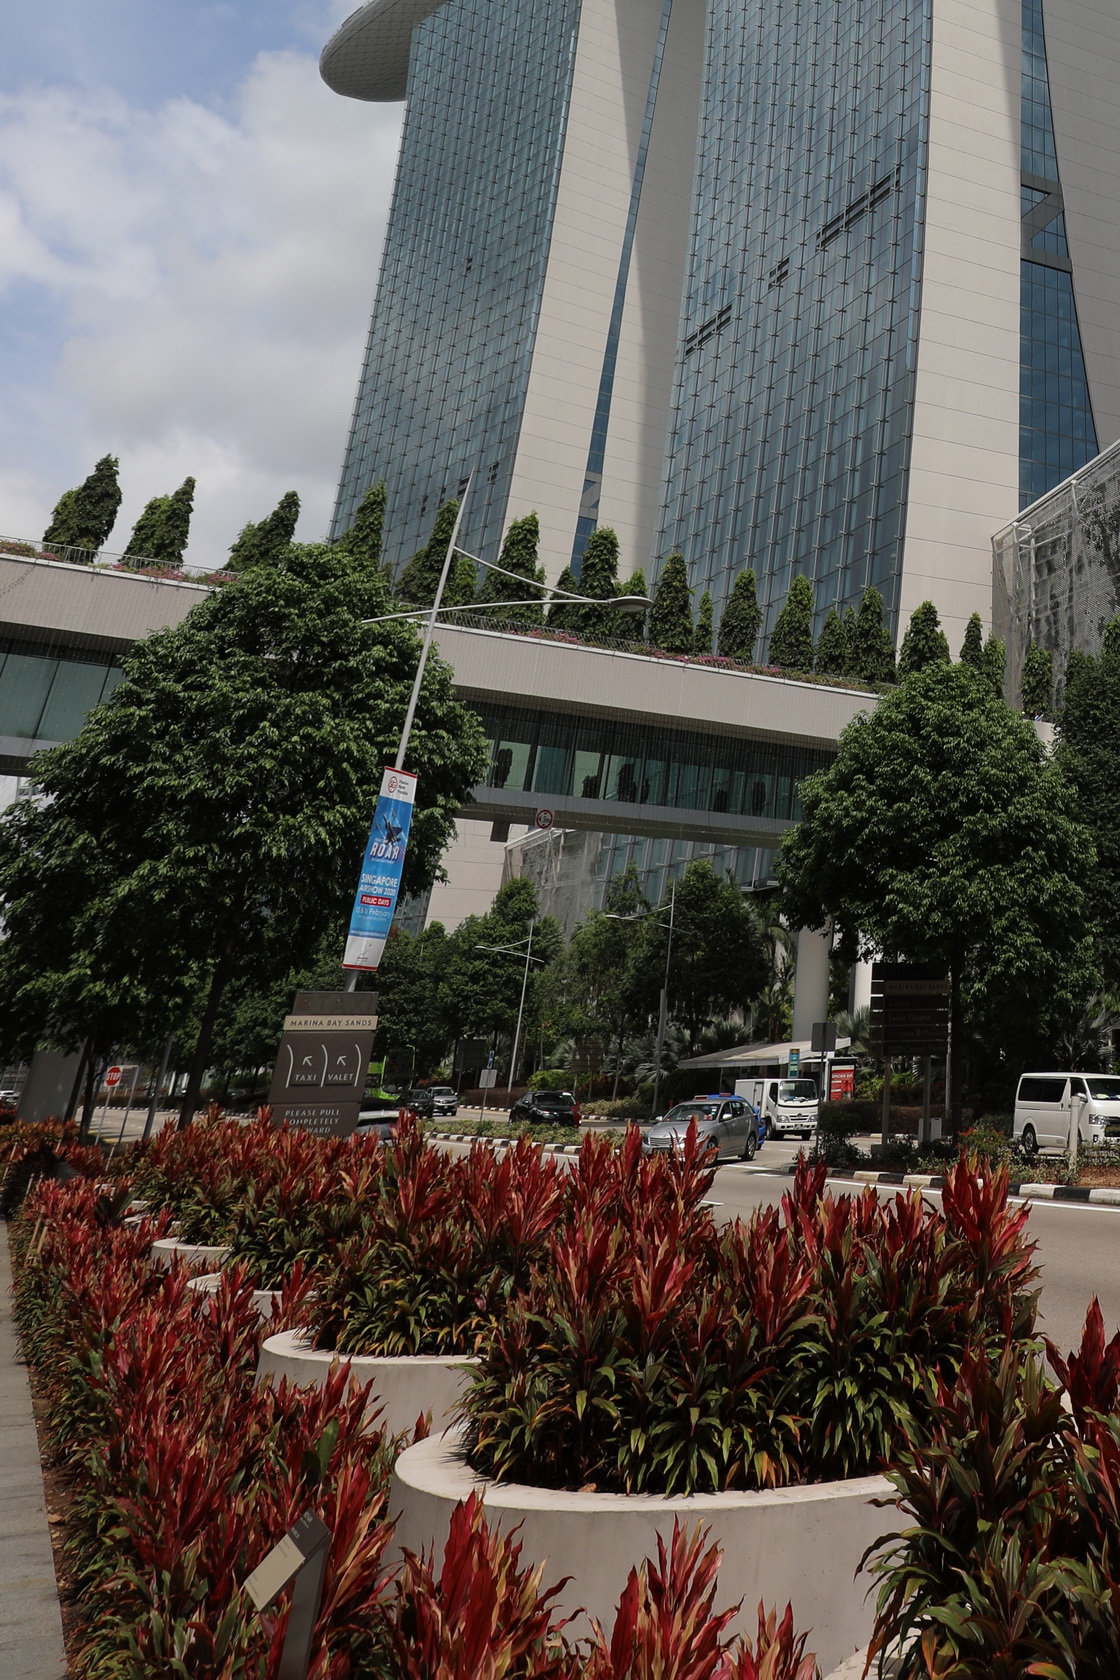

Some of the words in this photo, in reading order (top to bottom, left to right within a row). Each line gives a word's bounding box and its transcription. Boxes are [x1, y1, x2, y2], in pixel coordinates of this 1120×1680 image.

[370, 842, 400, 860] ROAR
[361, 873, 398, 888] SINGAPORE
[360, 884, 384, 894] AIRSHOW
[383, 887, 396, 896] 2020
[362, 896, 377, 905] PUBLIC
[377, 898, 390, 906] DAYS
[369, 907, 392, 919] February
[290, 1019, 324, 1027] MARINA
[106, 1072, 121, 1081] STOP
[327, 1073, 354, 1081] VALET
[285, 1109, 317, 1117] PLEASE
[319, 1108, 340, 1116] PULL
[288, 1118, 339, 1126] OMPLETELY
[288, 1126, 331, 1135] FOWARD
